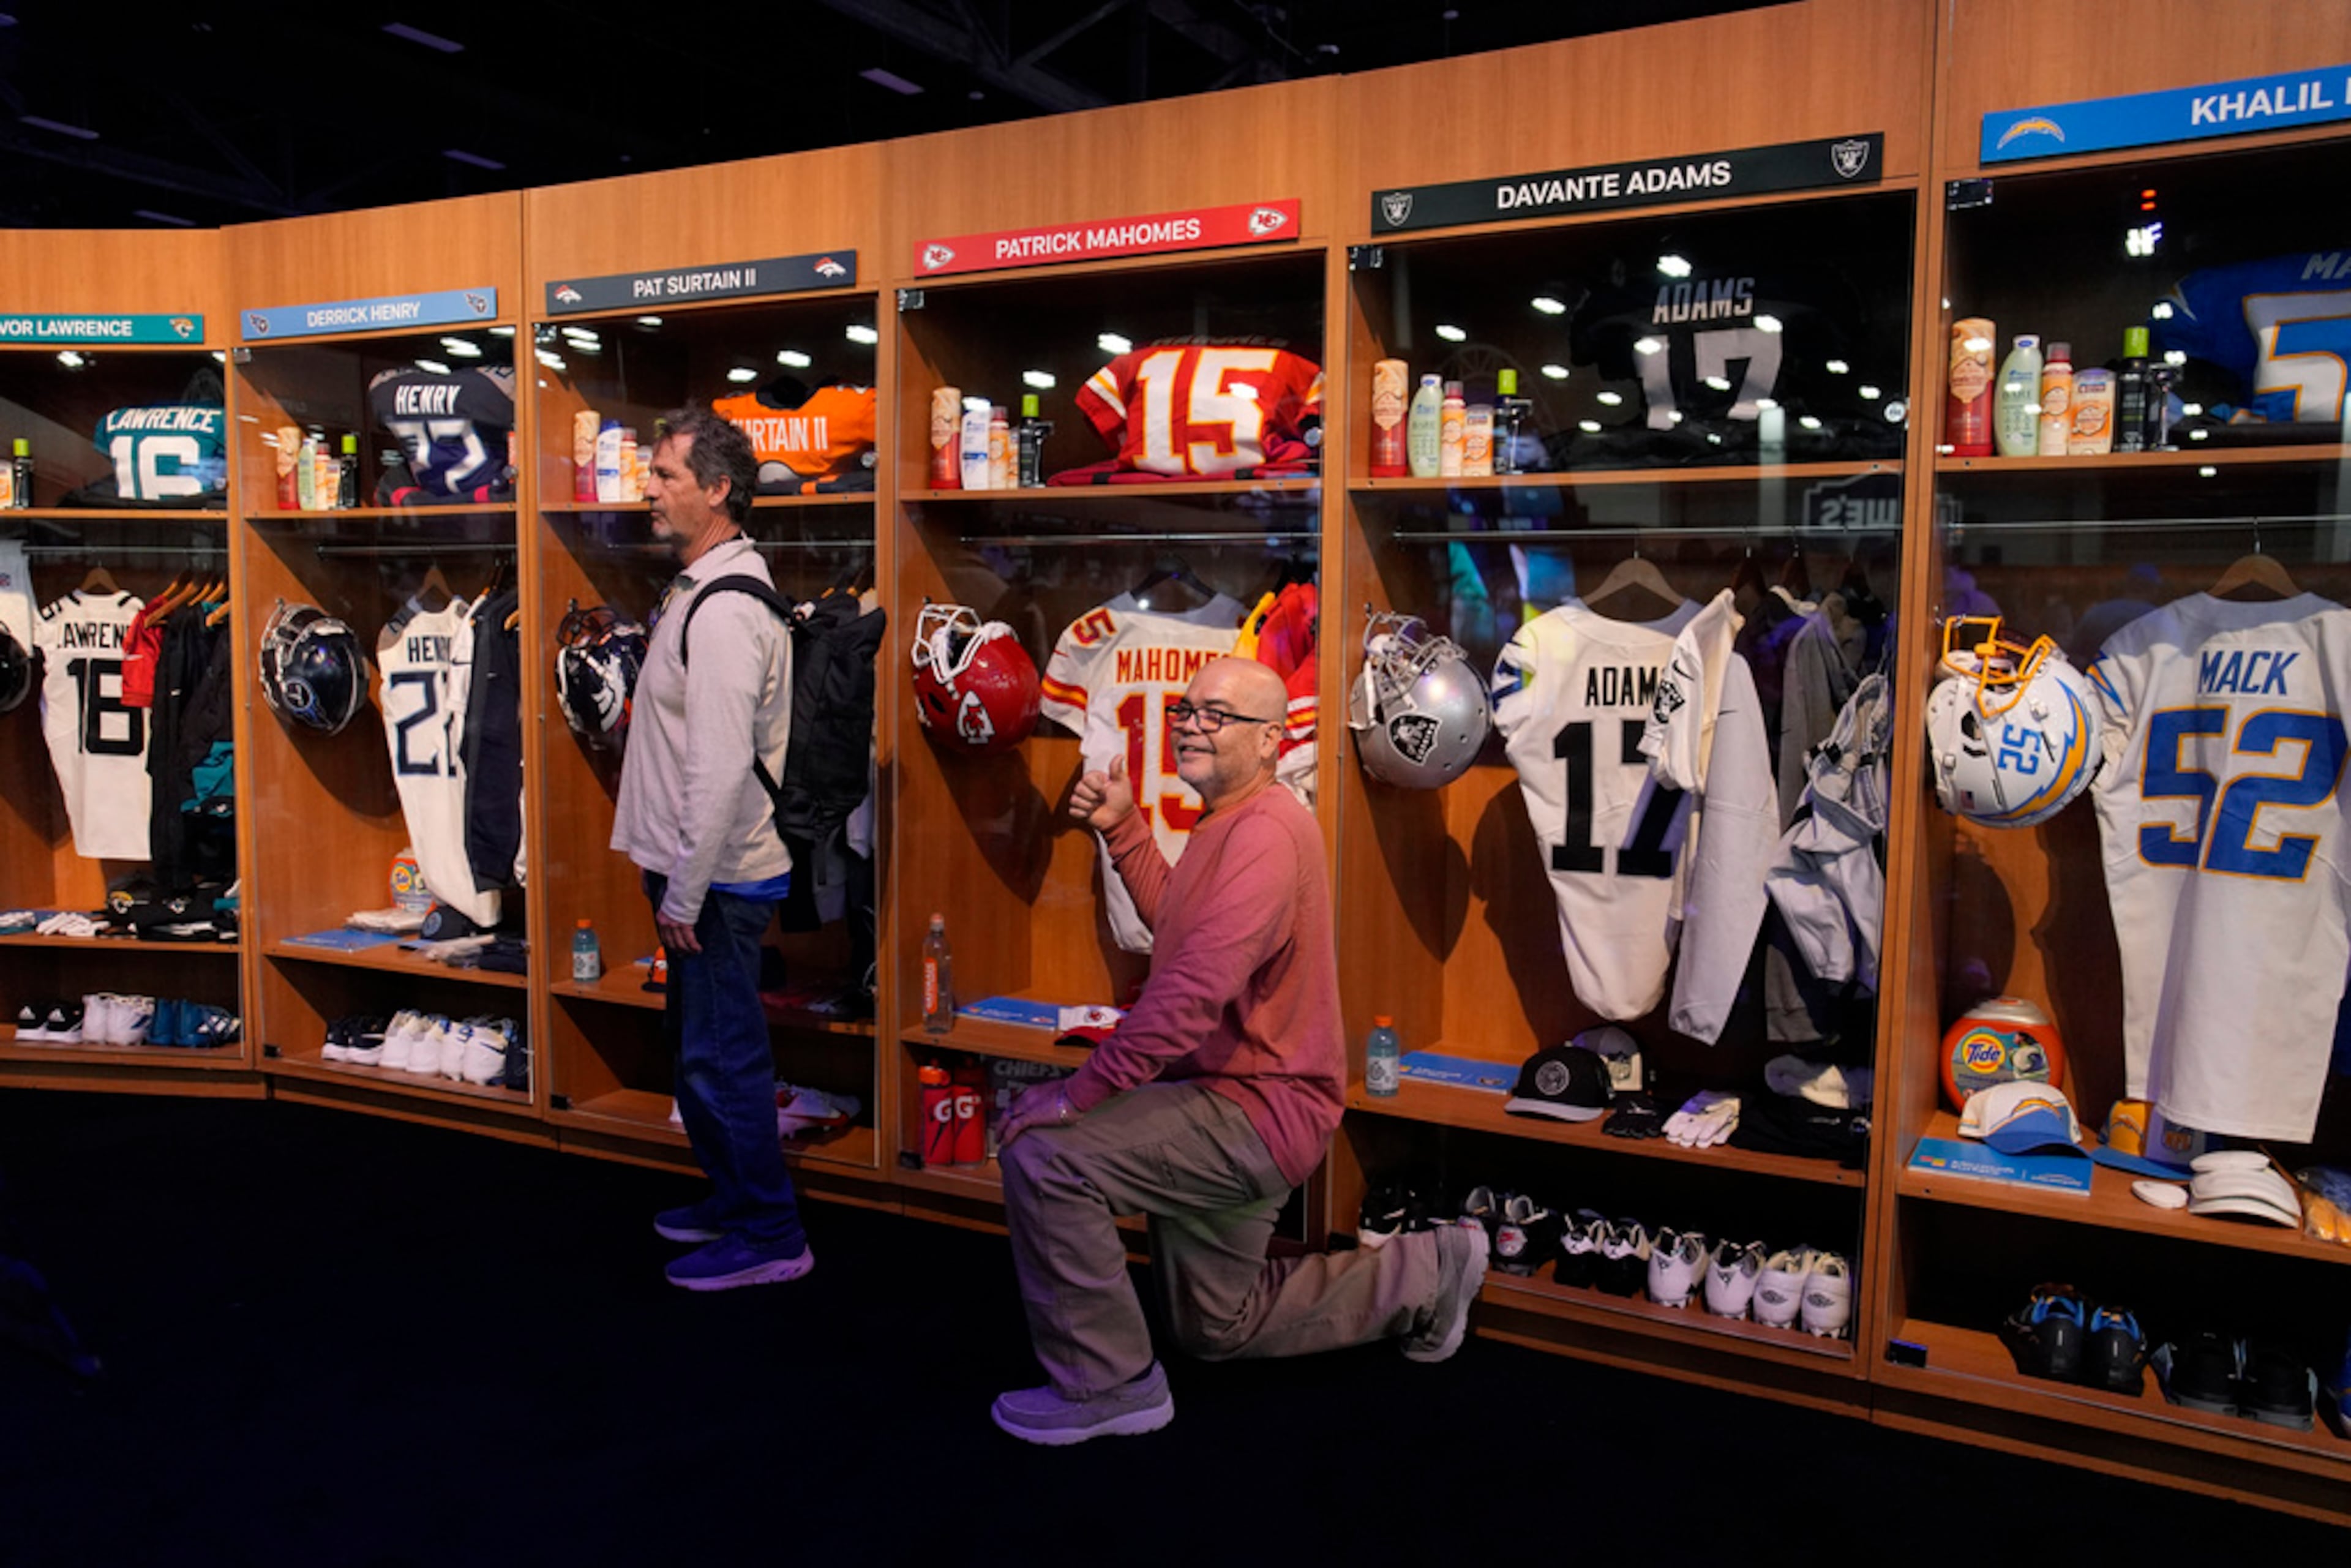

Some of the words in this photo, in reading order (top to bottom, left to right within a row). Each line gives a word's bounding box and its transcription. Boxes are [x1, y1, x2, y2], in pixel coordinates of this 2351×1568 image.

[2191, 81, 2334, 126] KHALIL
[1497, 174, 1621, 210] DAVANTE
[1626, 161, 1732, 195] ADAMS
[995, 230, 1082, 260] PATRICK
[1086, 218, 1201, 252] MAHOMES
[632, 277, 664, 298] PAT
[667, 269, 741, 295] SURTAIN
[744, 268, 757, 287] II
[1652, 277, 1755, 324] ADAMS
[37, 320, 133, 337] LAWRENCE
[306, 306, 368, 328] DERRICK
[370, 301, 421, 322] HENRY
[395, 384, 462, 415] HENRY
[1632, 327, 1783, 431] 17
[106, 407, 222, 433] LAWRENCE
[1132, 347, 1280, 476] 15
[729, 417, 809, 452] RTAIN
[813, 416, 828, 451] II
[109, 435, 203, 500] 16
[57, 622, 130, 649] AWREN
[1116, 647, 1231, 685] MAHOM
[1584, 666, 1660, 707] ADAM
[2196, 650, 2301, 696] MACK
[1997, 722, 2043, 776] 52
[1551, 718, 1685, 880] 17
[2138, 703, 2351, 883] 52
[994, 1060, 1062, 1079] CHIEFS
[1967, 1043, 2001, 1064] Tide
